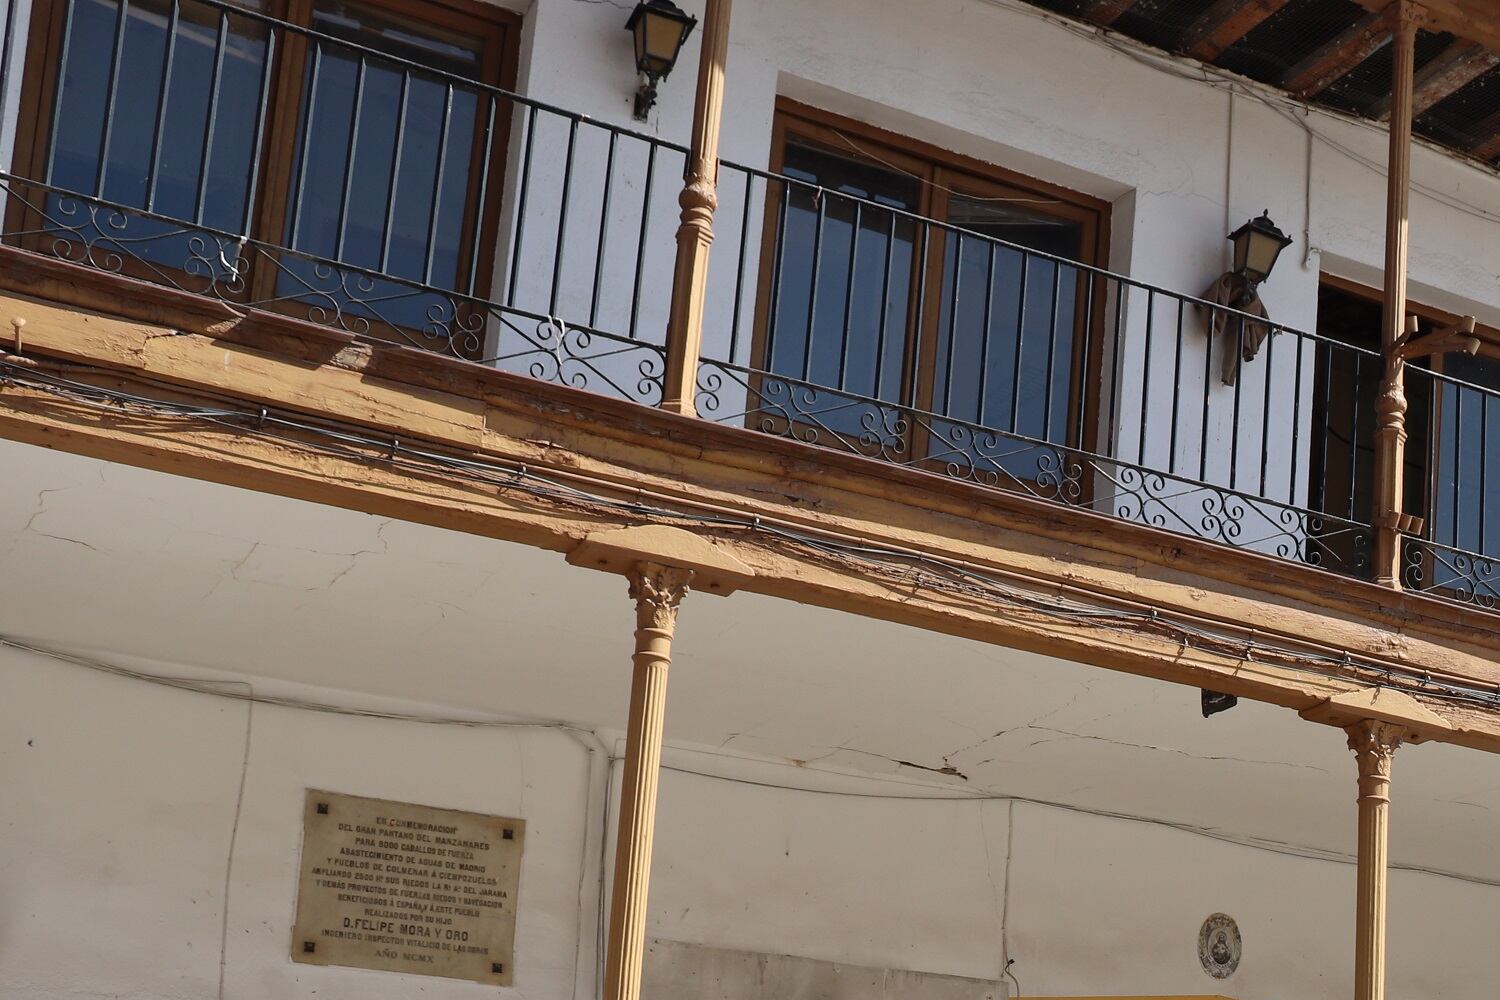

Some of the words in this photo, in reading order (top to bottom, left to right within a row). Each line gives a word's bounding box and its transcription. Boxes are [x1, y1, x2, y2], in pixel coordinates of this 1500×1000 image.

[338, 823, 352, 832] DEL
[356, 826, 376, 835] GRAN
[380, 829, 414, 838] PANTANO
[416, 833, 431, 842] DEL
[436, 836, 490, 850] MANZANARES
[355, 837, 376, 847] PARA
[378, 840, 398, 850] 8000
[400, 844, 436, 855] CABALLOS
[438, 848, 446, 856] DE
[448, 850, 474, 860] FUERZA
[334, 858, 370, 870] PUEBLOS
[372, 863, 382, 871] DE
[386, 864, 428, 877] COLMENAR
[438, 872, 496, 886] CIEMPOZUELOS
[340, 848, 403, 862] ABASTECIMIENTO
[406, 856, 416, 864] DE
[418, 858, 442, 868] AGUAS
[444, 862, 456, 870] DE
[459, 863, 486, 873] MADRID
[312, 867, 352, 879] AMPLIANDO
[385, 876, 400, 885] SUS
[402, 878, 429, 888] RIEGOS
[432, 882, 440, 890] LA
[464, 886, 476, 894] DEL
[479, 888, 507, 898] JARAMA
[316, 879, 320, 887] Y
[347, 883, 386, 895] PROYECTOS
[390, 888, 398, 896] DE
[458, 896, 462, 904] Y
[364, 908, 408, 920] REALIZADOS
[410, 913, 423, 922] POR
[436, 916, 452, 925] HIJO
[436, 906, 452, 914] ESTE
[321, 929, 362, 940] INGENIERO
[365, 934, 404, 946] INSPECTOR
[407, 938, 440, 950] VITALICIO
[442, 942, 452, 950] DE
[453, 944, 466, 953] LAS
[400, 924, 431, 938] MORA
[434, 928, 442, 938] Y
[446, 929, 468, 942] ORO
[375, 948, 398, 959] AÑO
[402, 952, 434, 964] MCMX
